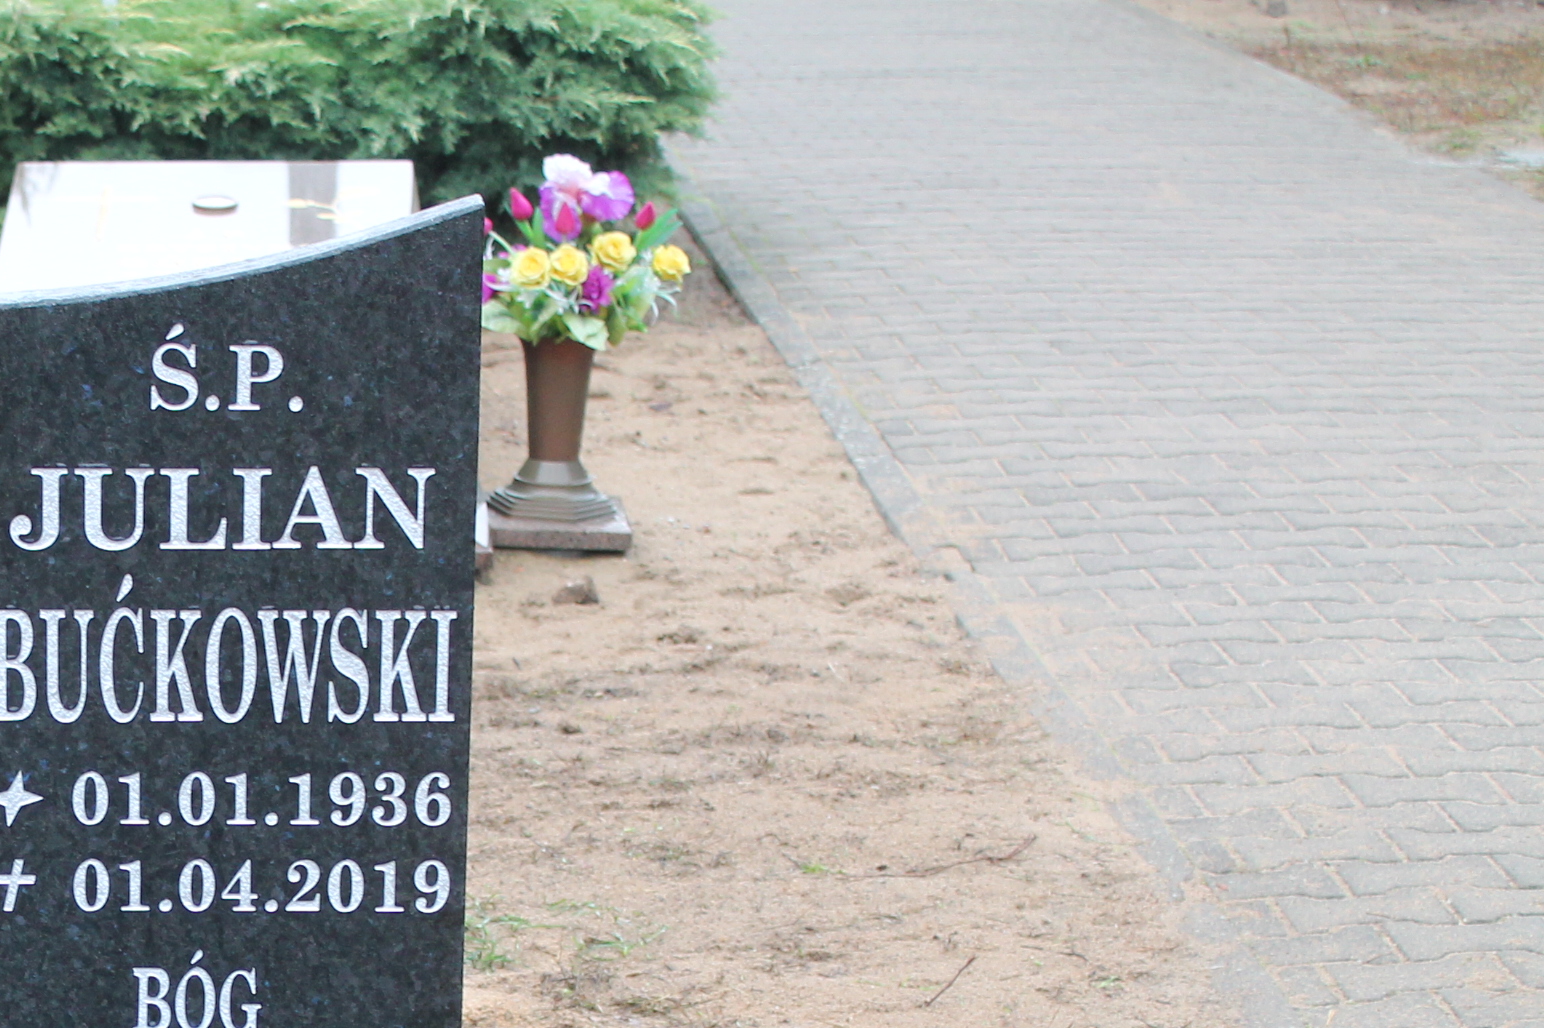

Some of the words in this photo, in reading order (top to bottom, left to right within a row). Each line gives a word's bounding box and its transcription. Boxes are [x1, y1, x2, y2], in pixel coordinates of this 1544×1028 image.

[150, 324, 303, 412] Ś.P.
[9, 466, 436, 551] JULIAN
[72, 771, 451, 826] 01.01.1936
[73, 859, 450, 913] 01.04.2019
